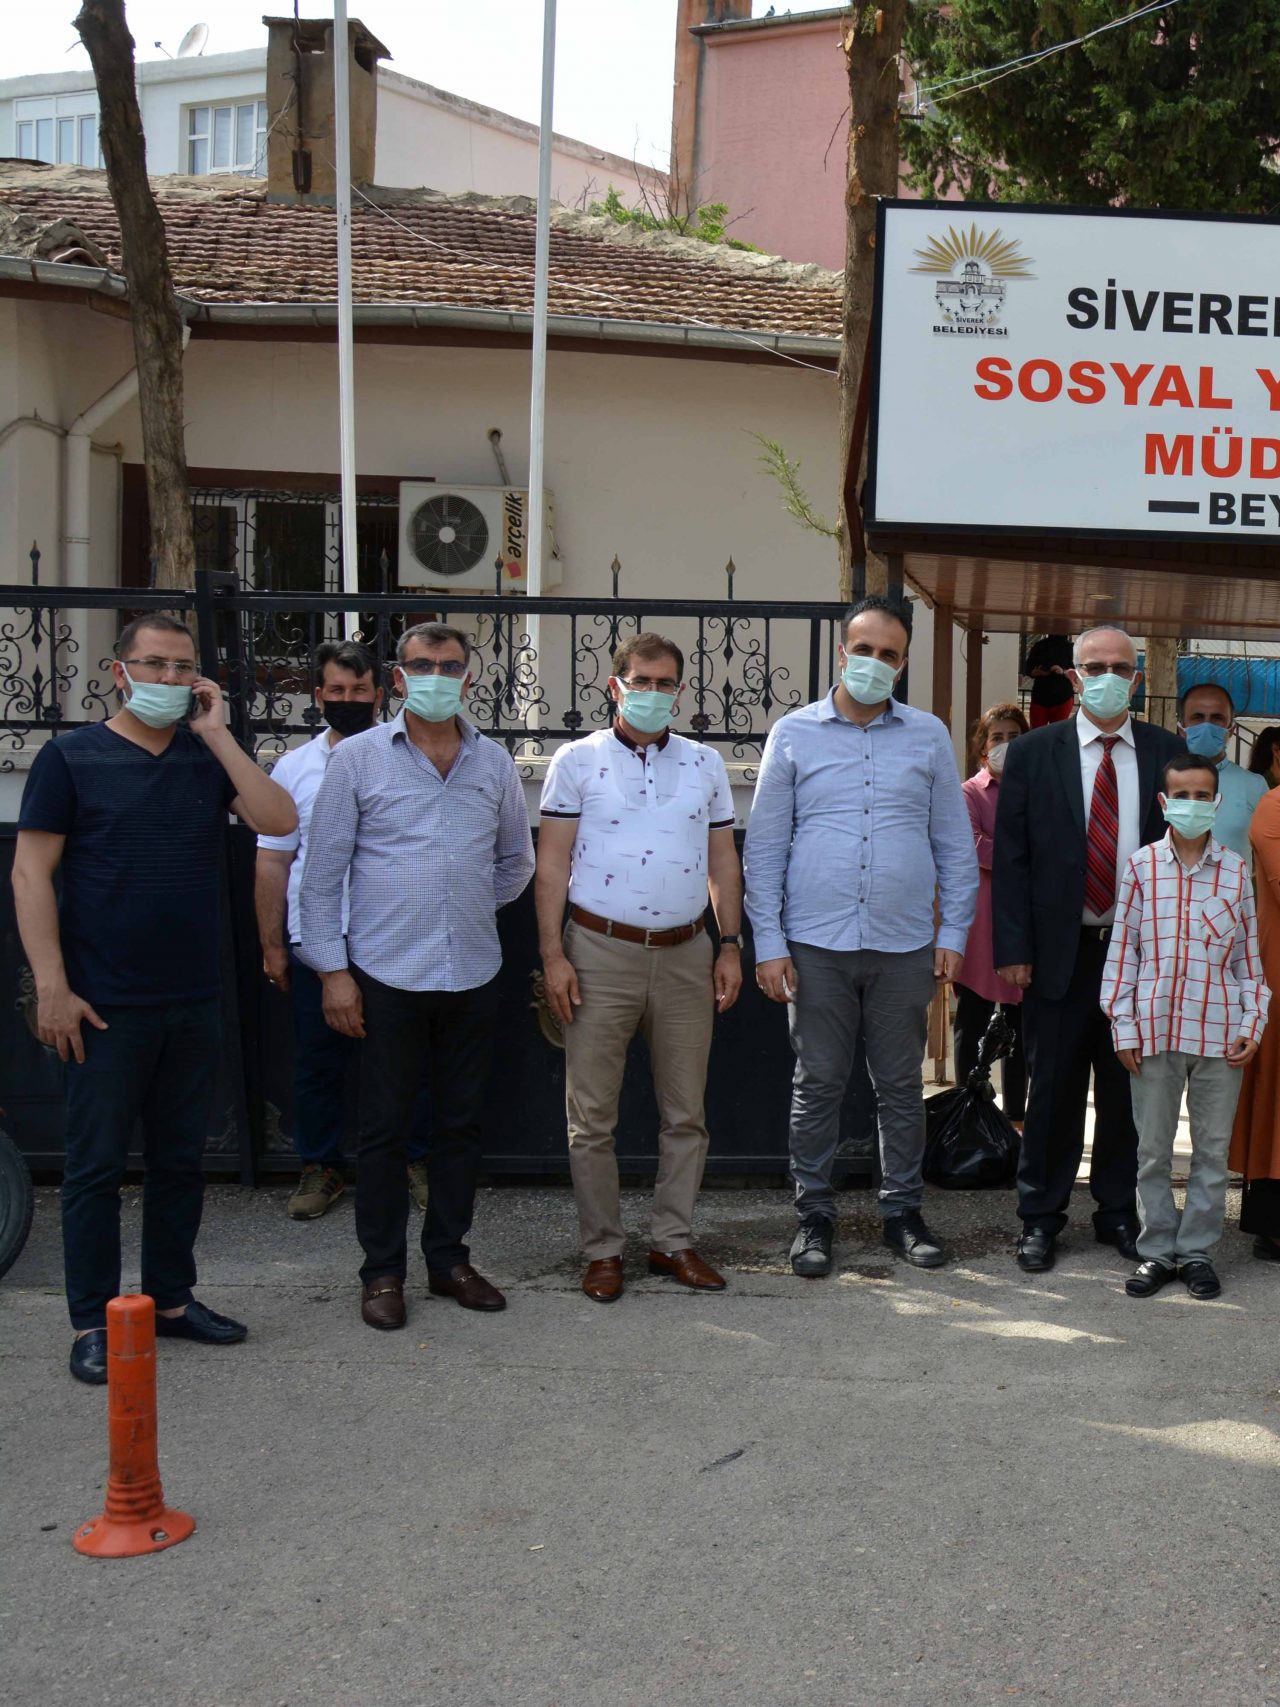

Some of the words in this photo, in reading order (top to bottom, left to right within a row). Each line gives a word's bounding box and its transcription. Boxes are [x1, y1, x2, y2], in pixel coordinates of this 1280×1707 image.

[932, 325, 1008, 336] BELEDİYESİ
[974, 357, 1233, 410] SOSYAL
[504, 492, 526, 559] arçelik
